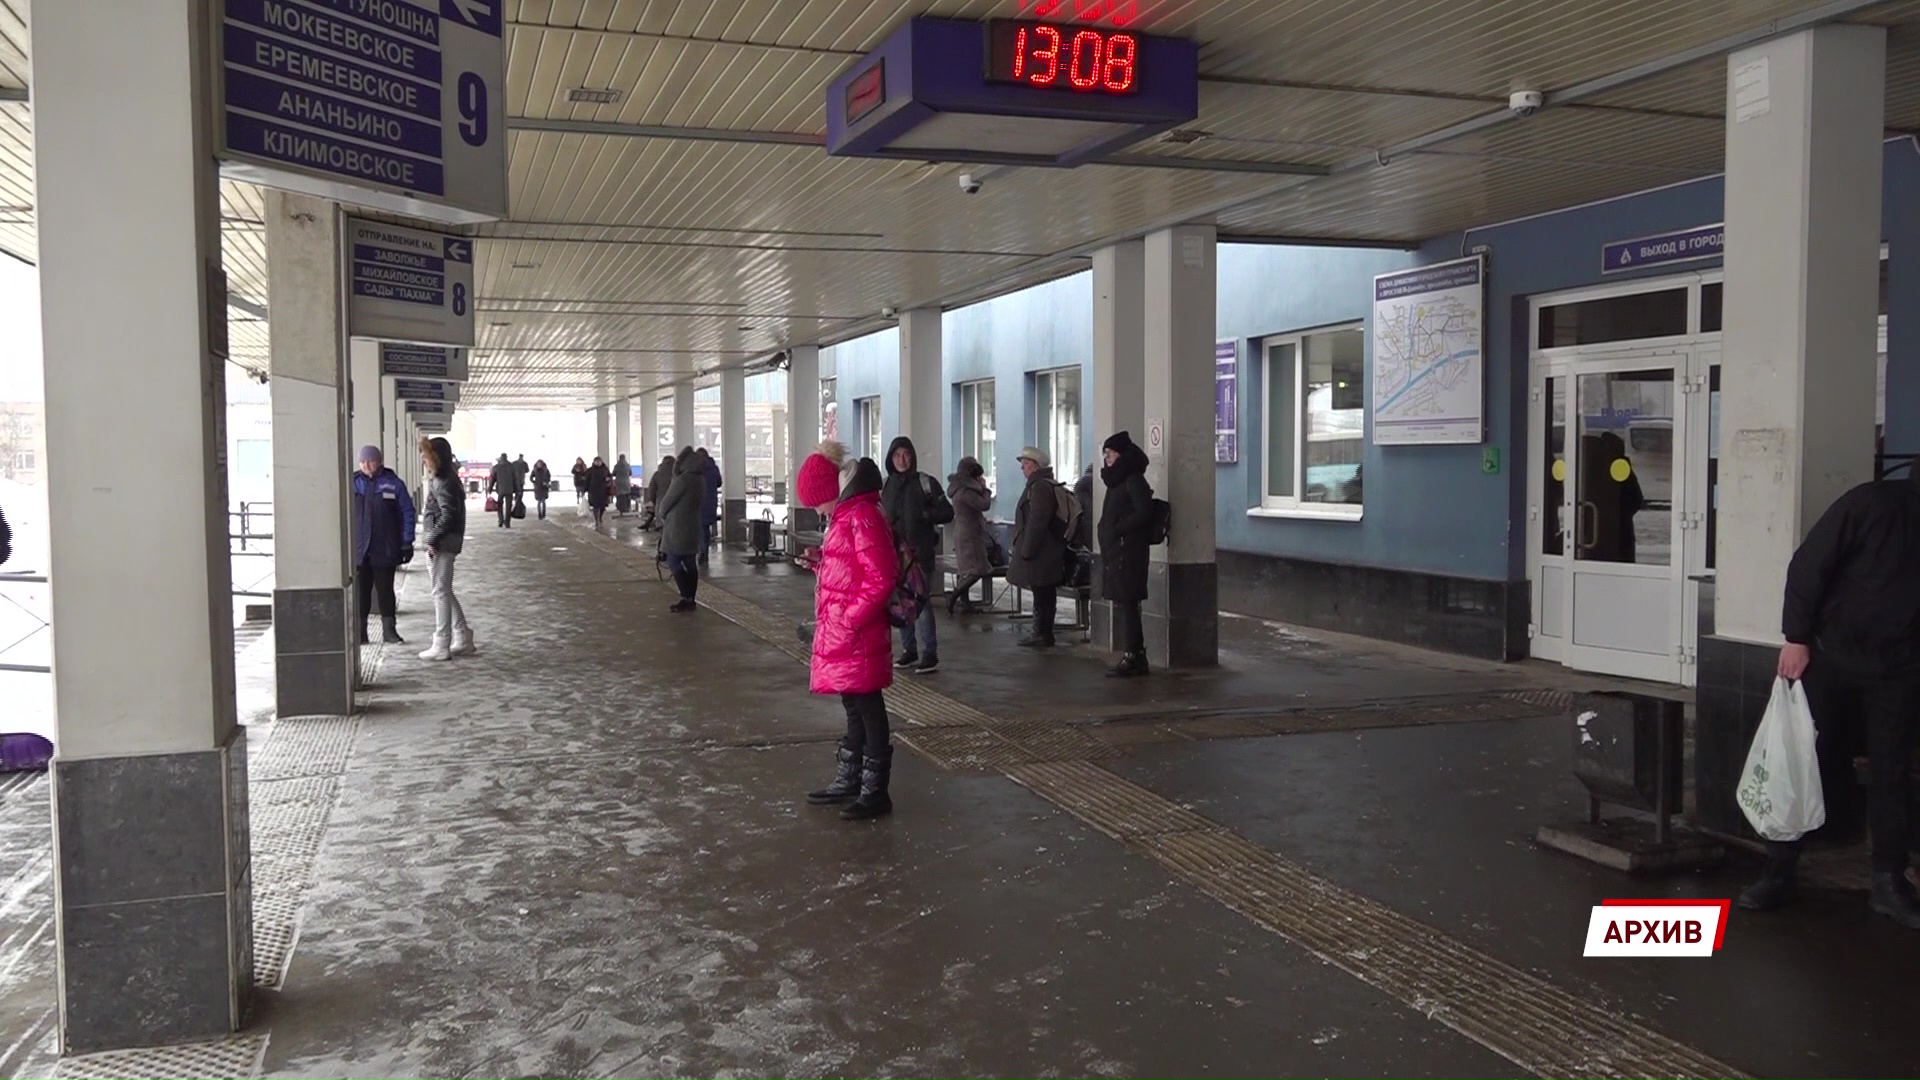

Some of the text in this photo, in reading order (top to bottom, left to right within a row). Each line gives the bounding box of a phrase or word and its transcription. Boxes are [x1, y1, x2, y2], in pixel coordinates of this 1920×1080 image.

[263, 1, 415, 69] МОКЕЕВСКОЕ
[255, 41, 417, 108] ЕРЕМЕЕВСКОЕ
[1013, 26, 1135, 90] 13:08
[278, 91, 402, 141] АНАНЬИНО
[458, 71, 488, 147] 9
[263, 129, 415, 184] КЛИМОВСКОЕ
[358, 229, 420, 248] ОТПРАВЛЕНИЕ
[374, 249, 427, 267] ЗАВОЛЖЬЕ
[1640, 233, 1724, 258] ВЫХОД В ГОРОД
[362, 266, 439, 287] МИХАЙЛОВСКОЕ
[364, 283, 437, 301] САДЫ "ПАХМА"
[452, 282, 466, 316] 8
